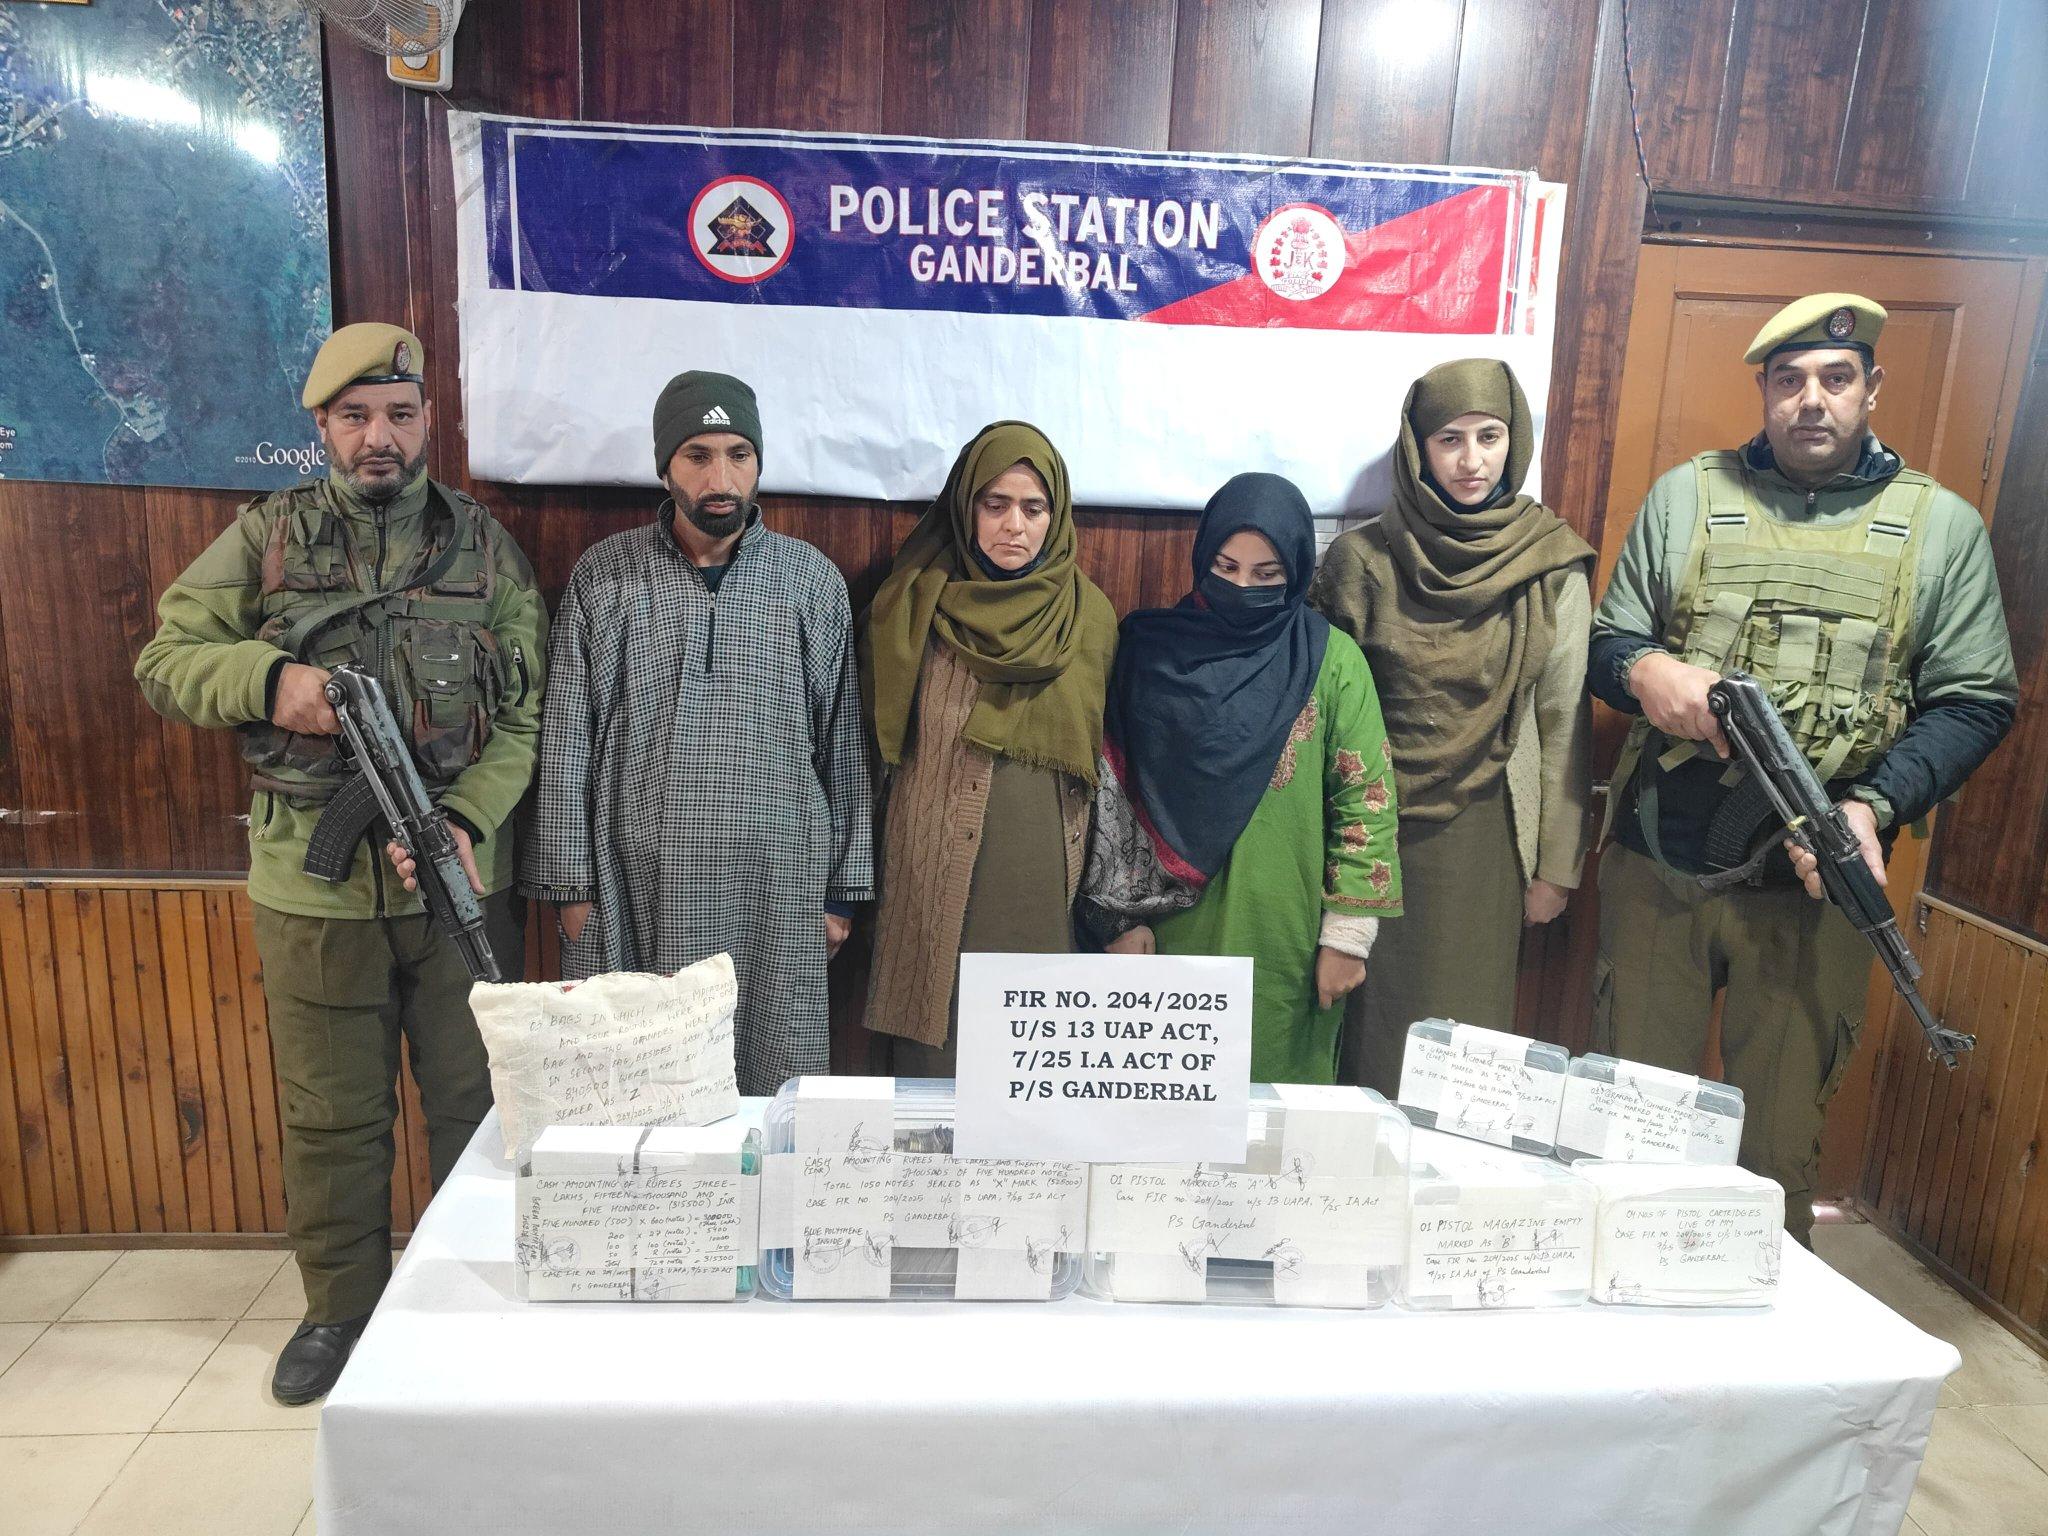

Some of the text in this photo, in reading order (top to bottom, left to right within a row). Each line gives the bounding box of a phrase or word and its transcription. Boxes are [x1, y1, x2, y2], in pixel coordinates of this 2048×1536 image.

[829, 184, 1220, 250] POLICE STATION
[909, 243, 1138, 292] GANDERBAL
[256, 441, 326, 474] Google
[1003, 990, 1228, 1013] FIR NO. 204/2025
[1010, 1019, 1219, 1046] U/S 13 UAP ACT,
[1012, 1050, 1216, 1071] 7/25 I.A ACT OF
[1009, 1080, 1218, 1102] P/S GANDERBAL
[804, 1156, 832, 1167] CASH
[842, 1155, 892, 1167] AMOUNTING
[902, 1155, 933, 1166] RUPEES
[956, 1168, 968, 1176] OF
[976, 1168, 993, 1176] FIVE
[1040, 1169, 1069, 1178] NOTES
[564, 1180, 618, 1189] AMOUNTING
[645, 1179, 683, 1188] RUPEES
[823, 1182, 852, 1191] TOTAL
[859, 1180, 881, 1189] 1050
[884, 1179, 916, 1188] NOTES
[927, 1179, 962, 1188] SEALED
[969, 1179, 980, 1187] AS
[1011, 1179, 1038, 1189] MARK
[1130, 1174, 1167, 1186] PISTOL
[593, 1191, 631, 1200] FIFTEEN
[696, 1191, 715, 1199] AND
[805, 1197, 828, 1208] CASE
[883, 1193, 925, 1206] 204/2025
[1046, 1193, 1067, 1201] ACT
[1145, 1191, 1168, 1203] FIR
[1194, 1194, 1234, 1212] 204/2025
[1345, 1196, 1361, 1207] IA
[582, 1205, 603, 1216] FIVE
[882, 1211, 957, 1222] PS GANDERBAL
[1676, 1208, 1703, 1218] PISTOL
[604, 1216, 633, 1228] (500)
[1167, 1214, 1184, 1229] PS
[1436, 1219, 1474, 1233] PISTOL
[1482, 1218, 1547, 1231] MAGAZINE
[607, 1231, 625, 1240] 200
[1437, 1239, 1474, 1249] MARKED
[1679, 1253, 1729, 1264] GANDERBAL
